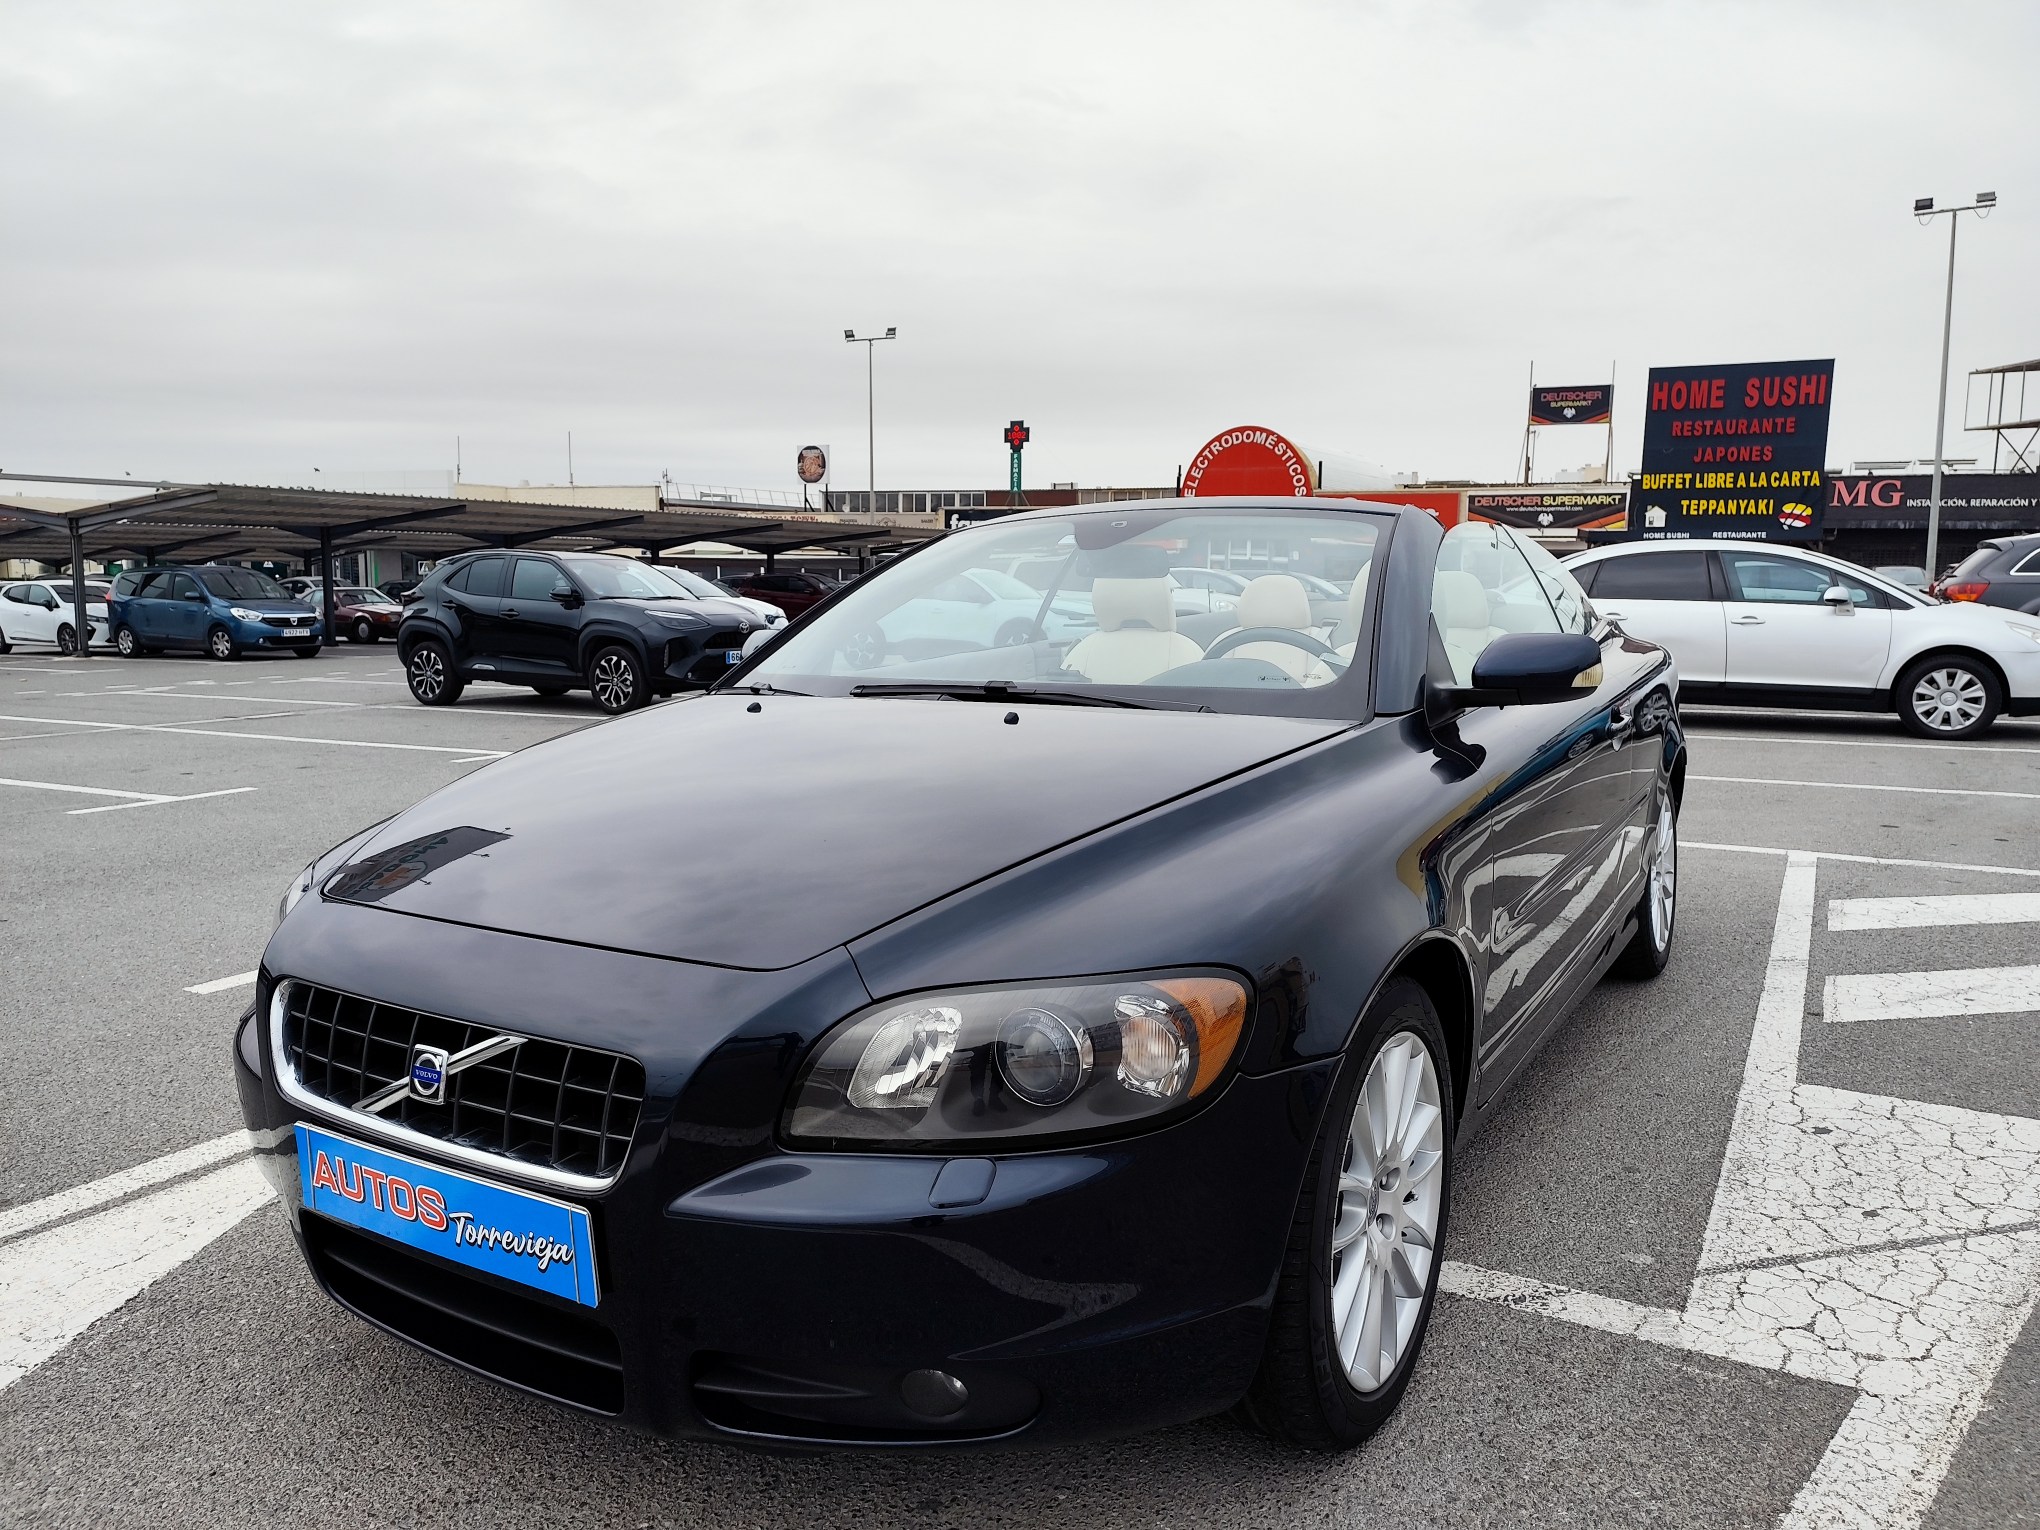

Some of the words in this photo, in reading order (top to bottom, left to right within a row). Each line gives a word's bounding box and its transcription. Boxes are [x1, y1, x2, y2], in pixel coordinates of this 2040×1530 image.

[1541, 391, 1602, 402] DEUTSCHER
[1652, 380, 1726, 411] HOME
[1744, 374, 1827, 408] SUSHI
[1550, 400, 1592, 408] SUPERMARKT
[1672, 417, 1796, 436] RESTAURANTE
[1693, 445, 1773, 463] JAPONES
[1184, 430, 1307, 497] ELECTRODOMÉSTICOS
[1642, 473, 1692, 490] BUFFET
[1695, 473, 1734, 489] LIBRE
[1736, 472, 1747, 488] A
[1749, 472, 1767, 488] LA
[1770, 471, 1821, 488] CARTA
[1475, 496, 1541, 506] DEUTSCHER
[1542, 495, 1621, 505] SUPERMARKT
[1829, 479, 1905, 507] MG
[1681, 499, 1774, 516] TEPPANYAKI
[1906, 497, 1968, 507] INSTACIÓN,
[1970, 497, 2029, 507] REPARACIÓN
[1712, 531, 1767, 539] RESTAURANTE
[415, 1069, 438, 1080] VOLVO
[313, 1150, 450, 1232] AUTOS
[449, 1211, 575, 1272] Torrevieja
